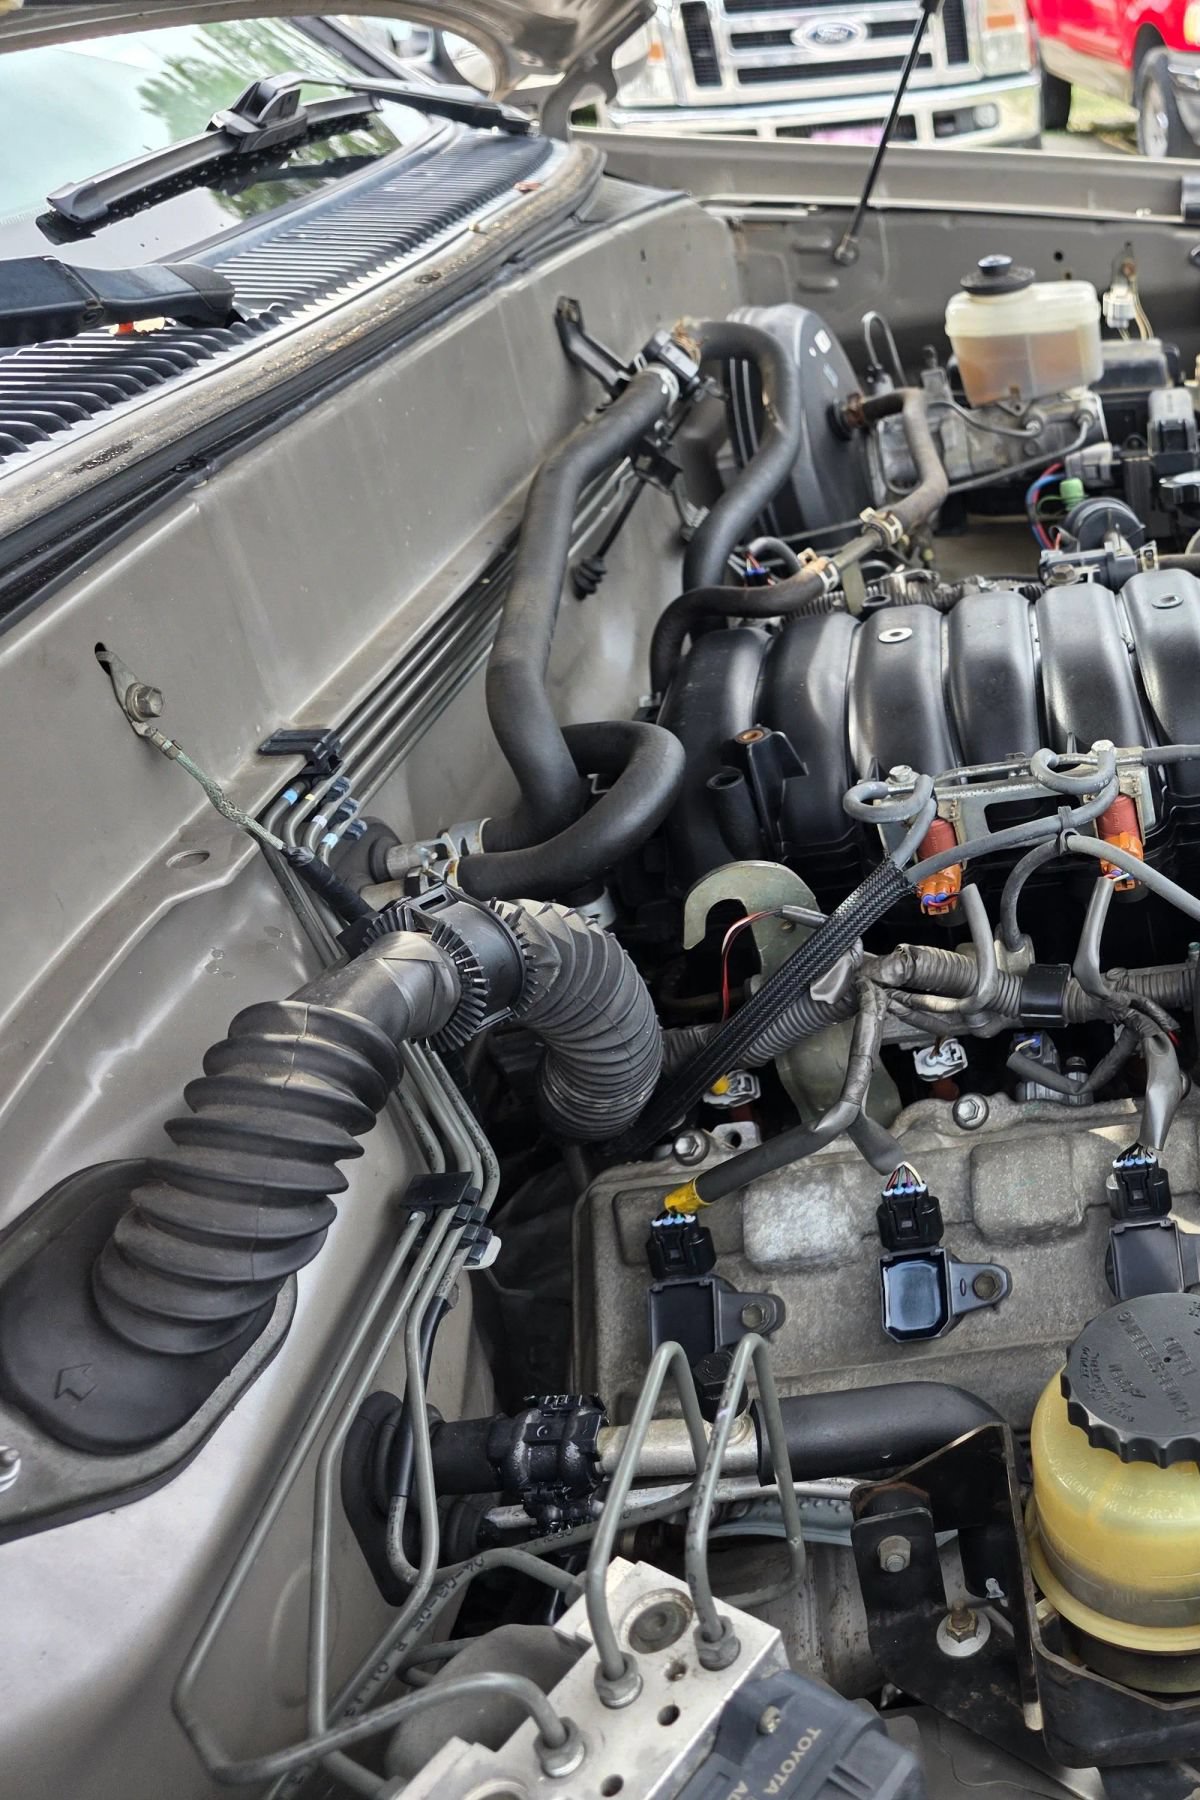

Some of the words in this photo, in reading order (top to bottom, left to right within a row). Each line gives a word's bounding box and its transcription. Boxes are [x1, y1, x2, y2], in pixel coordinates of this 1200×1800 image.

[1115, 1310, 1166, 1375] STEERING
[1160, 1335, 1198, 1377] FLUID
[1153, 1371, 1197, 1425] POWER
[764, 1727, 821, 1794] TOYOTA
